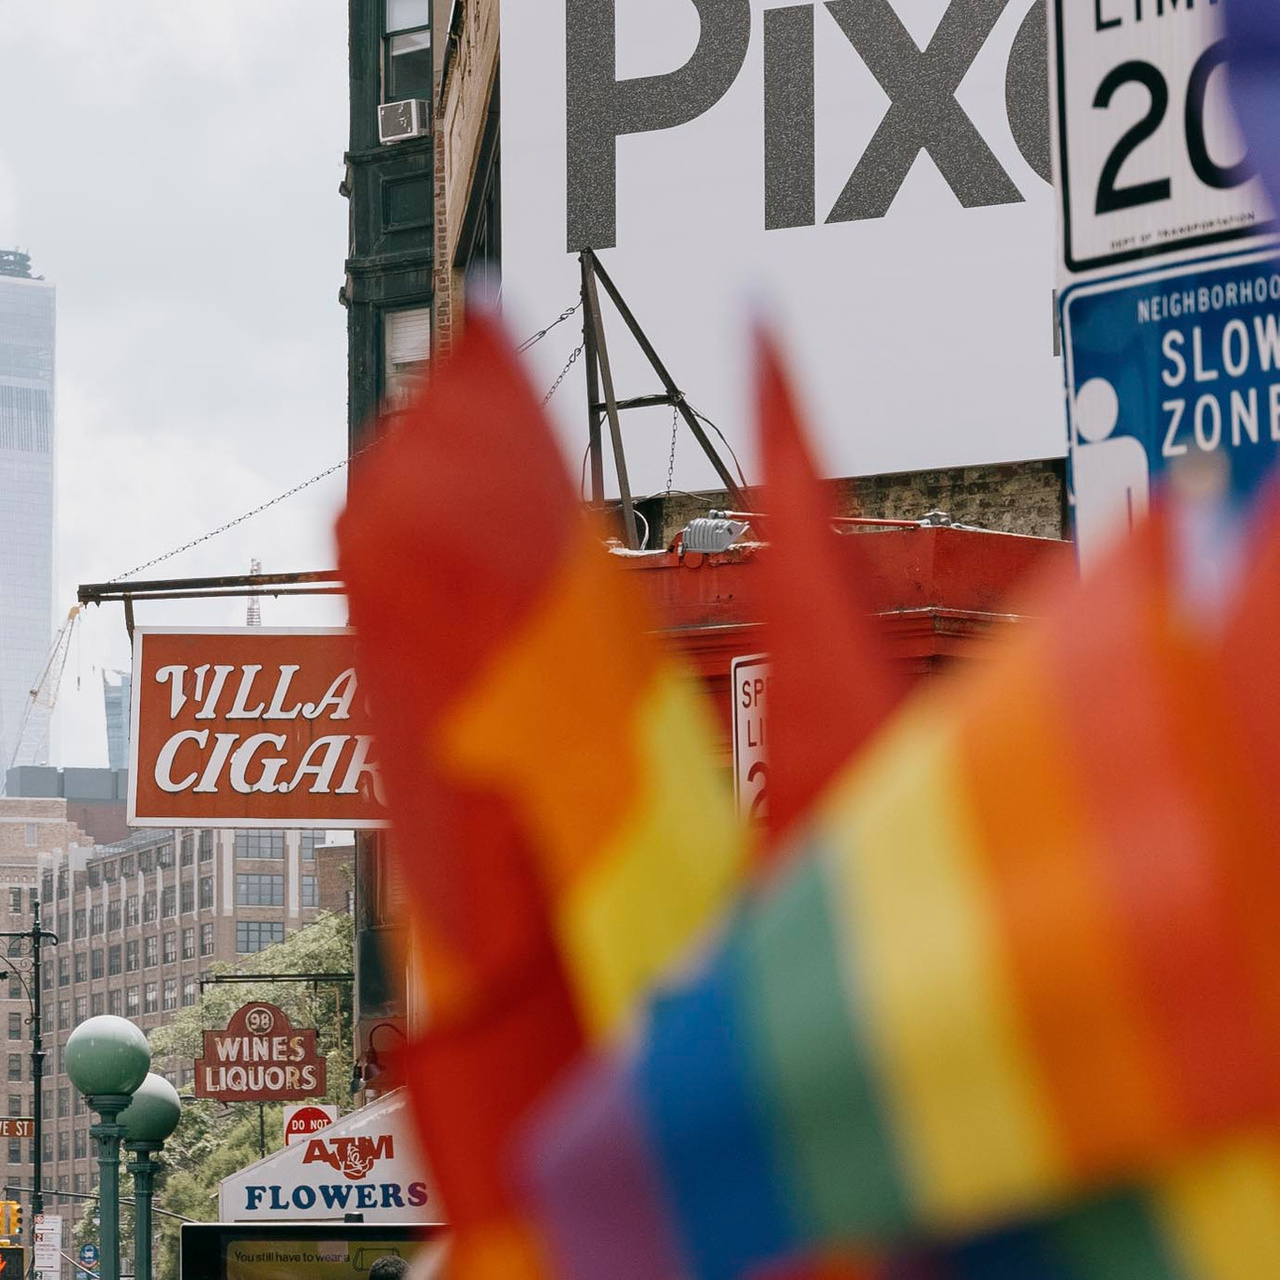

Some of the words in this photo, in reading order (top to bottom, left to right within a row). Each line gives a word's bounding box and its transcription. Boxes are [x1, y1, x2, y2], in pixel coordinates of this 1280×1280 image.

[1161, 314, 1280, 387] SLOW
[155, 664, 358, 720] VILLA
[249, 1013, 270, 1029] 98
[215, 1036, 306, 1062] WINES
[205, 1065, 317, 1092] LIQUORS
[16, 1120, 29, 1136] ST
[292, 1120, 304, 1130] DO
[310, 1119, 328, 1130] NOT
[245, 1182, 428, 1210] FLOWERS
[235, 1252, 255, 1263] You
[256, 1252, 274, 1263] still
[276, 1252, 301, 1263] have
[303, 1252, 315, 1263] to
[316, 1254, 342, 1263] wear
